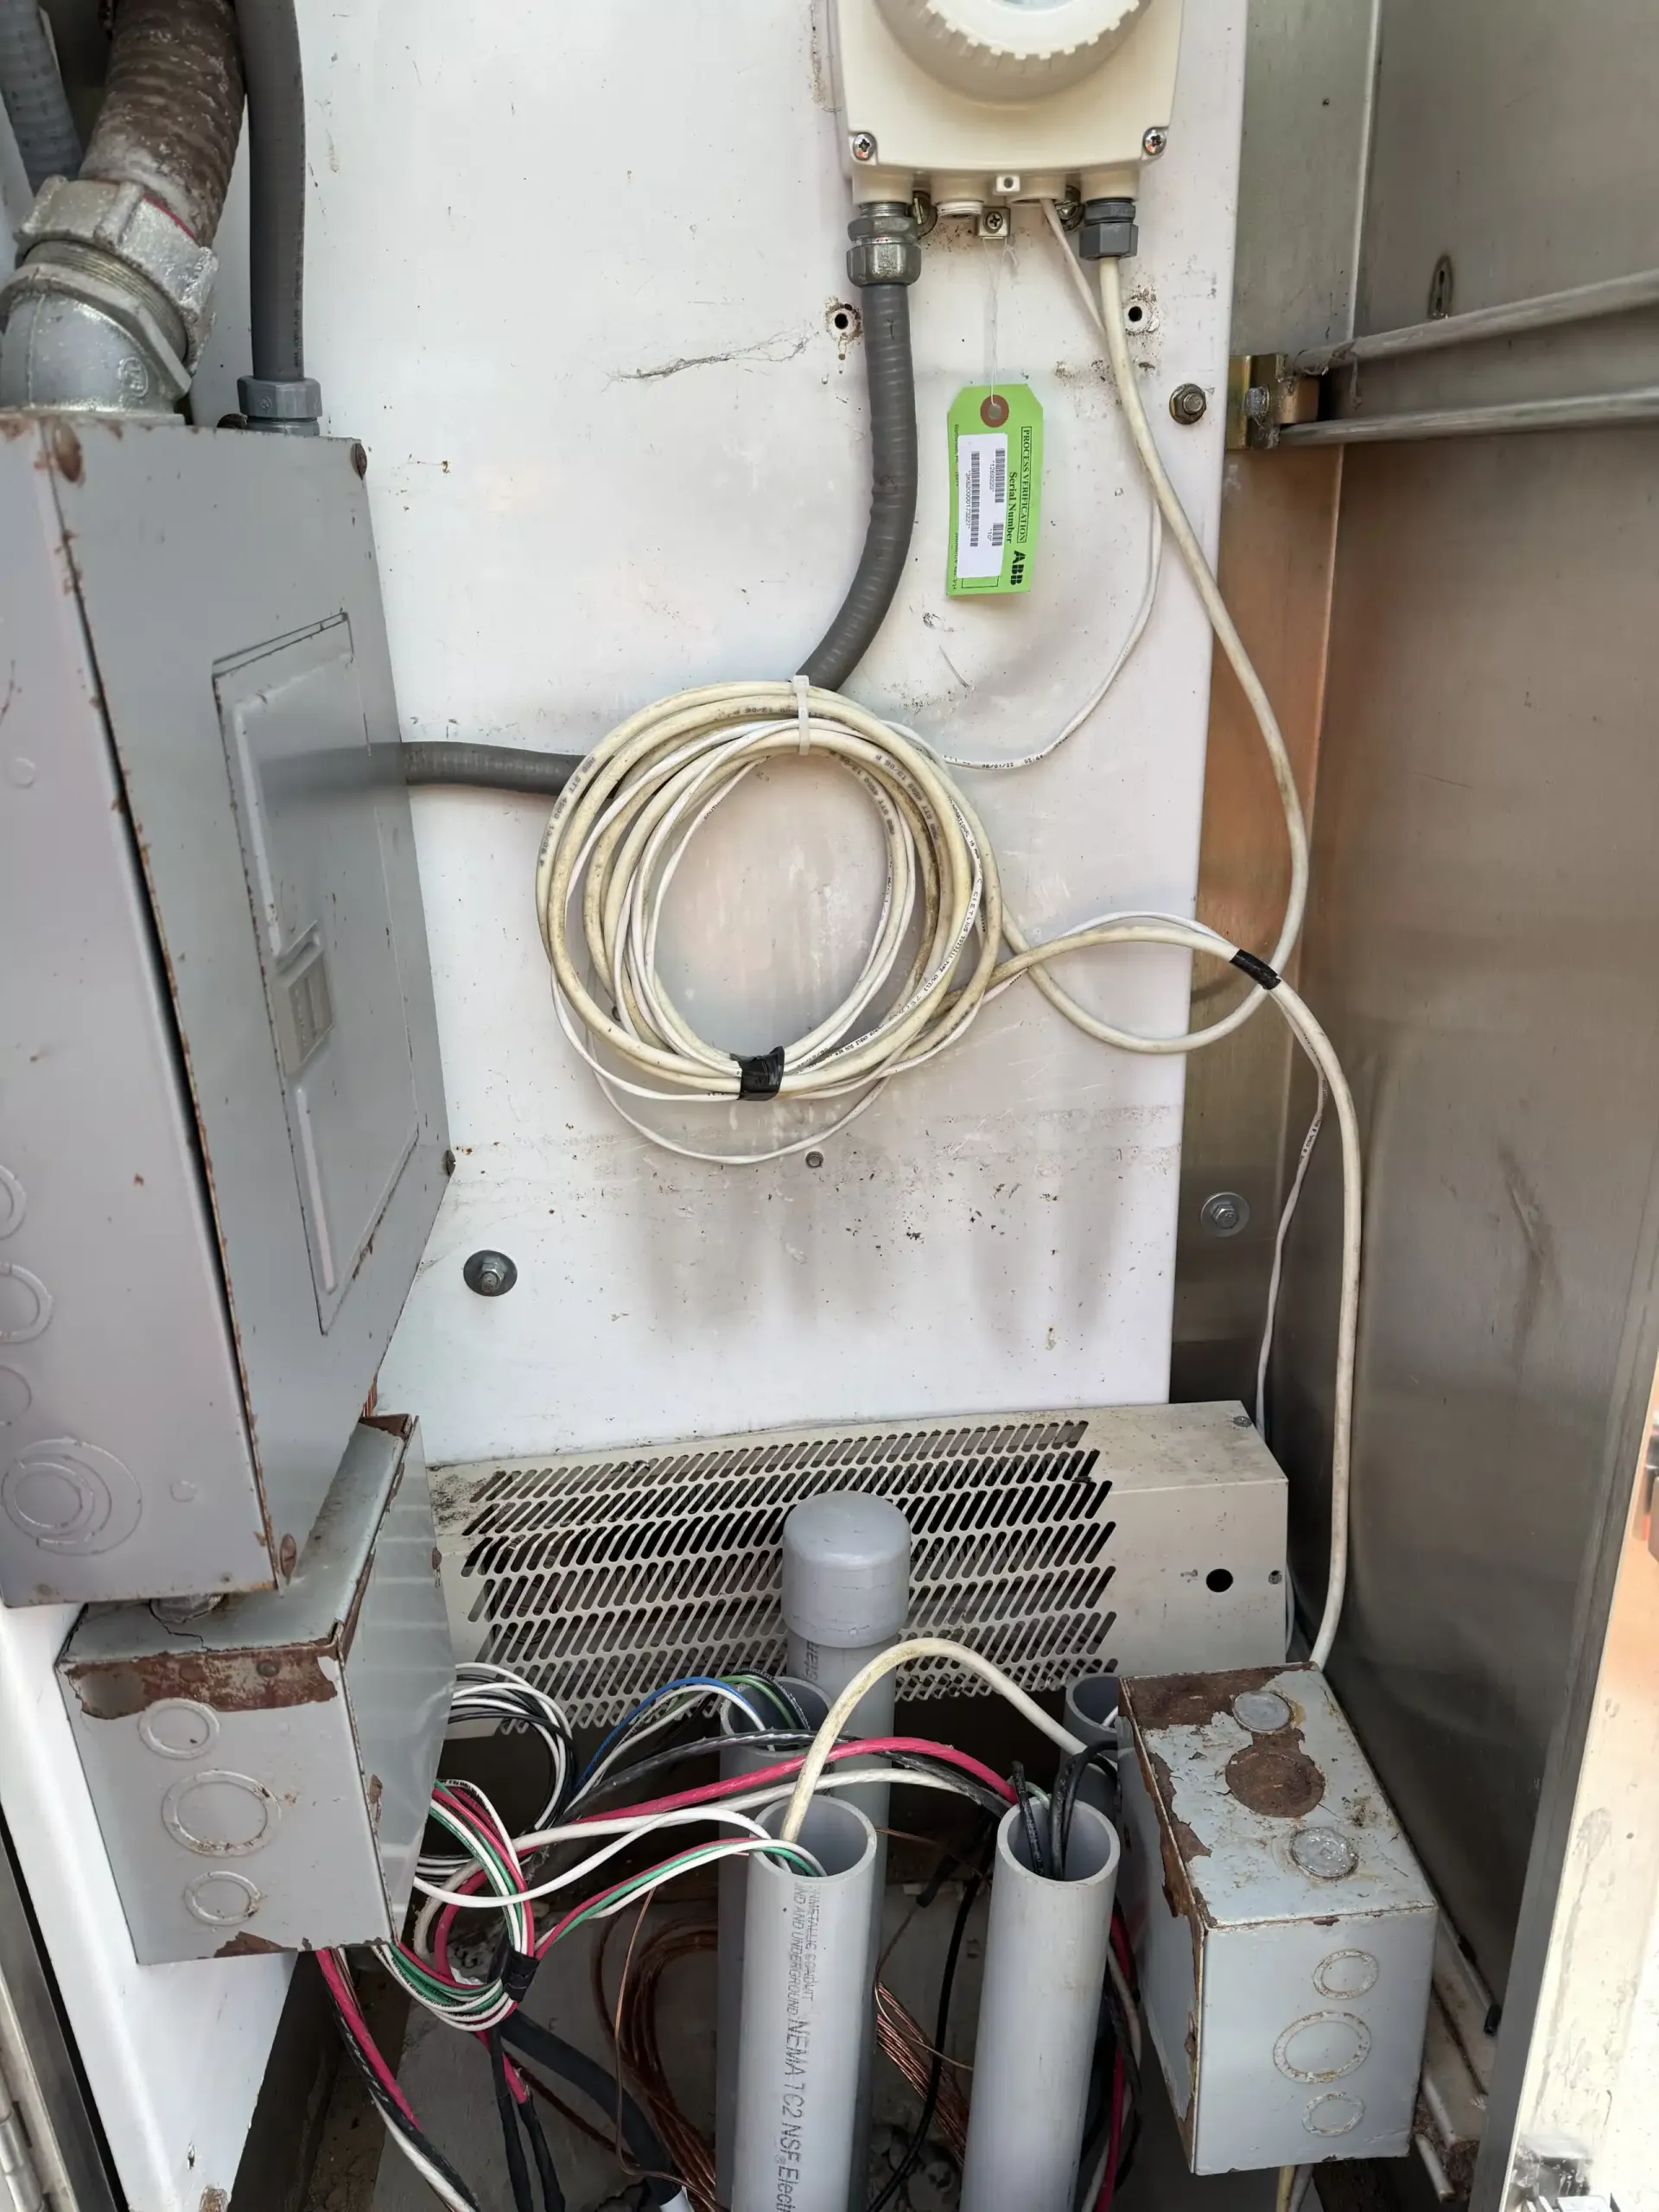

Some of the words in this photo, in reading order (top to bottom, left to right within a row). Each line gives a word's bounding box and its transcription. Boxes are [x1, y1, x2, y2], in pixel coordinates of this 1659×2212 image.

[1008, 472, 1018, 500] Serial
[1006, 503, 1016, 543] Number
[1019, 474, 1030, 541] VERIFICATION
[1010, 550, 1027, 586] ABB
[792, 1905, 805, 1929] AND
[787, 1932, 804, 2016] UNDERGROUND
[785, 2018, 810, 2075] NEMA
[779, 2122, 803, 2163] NSF
